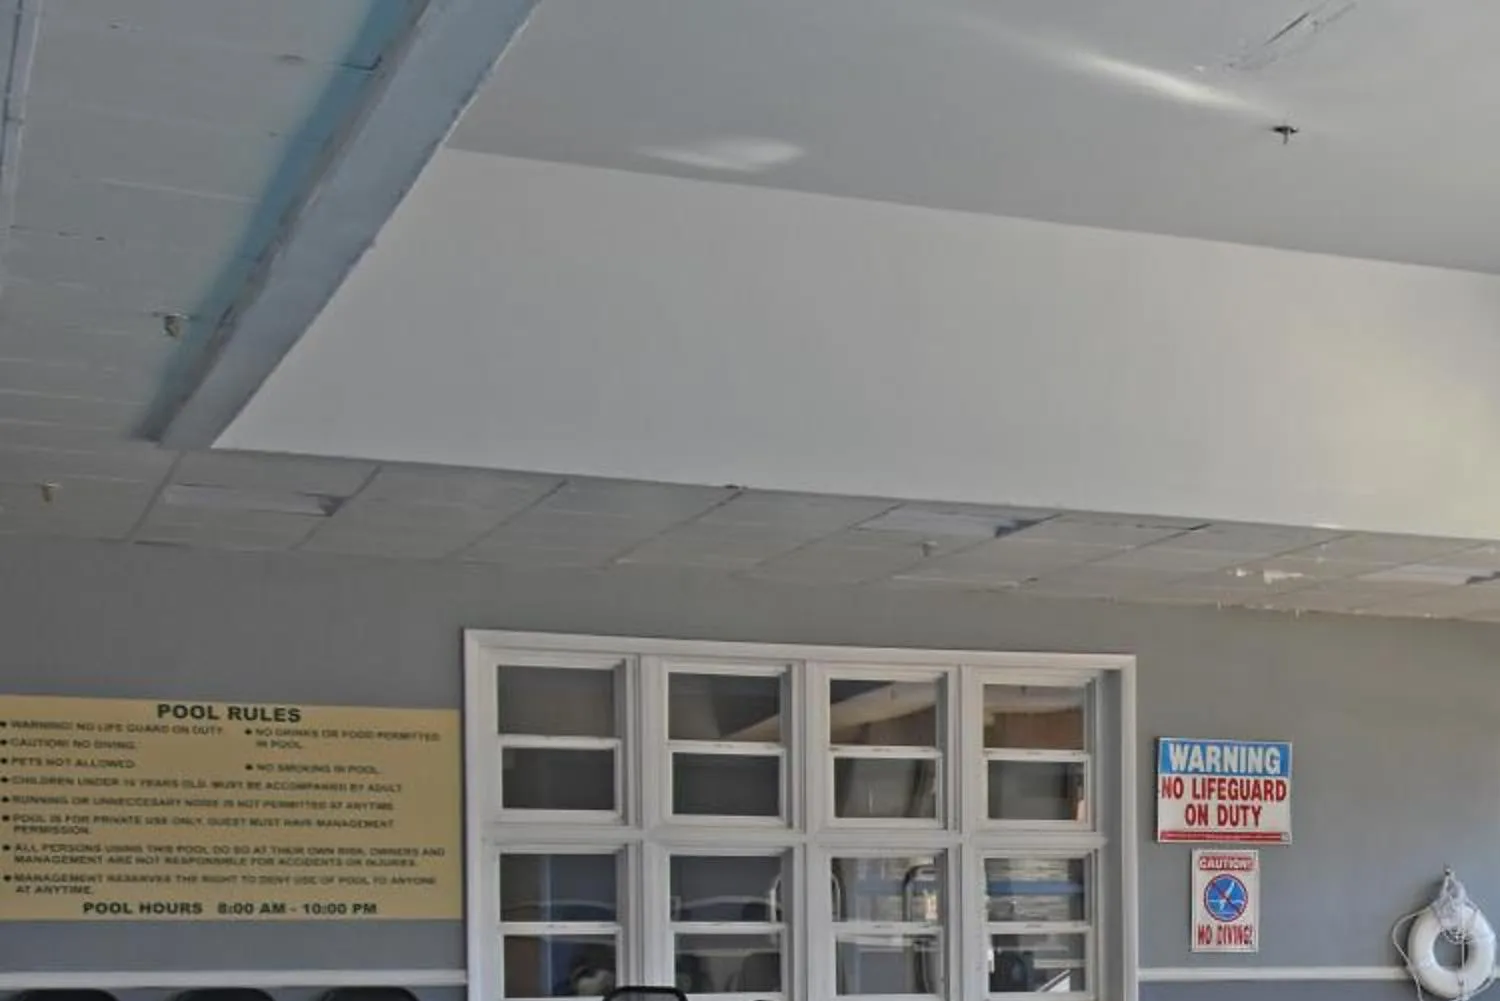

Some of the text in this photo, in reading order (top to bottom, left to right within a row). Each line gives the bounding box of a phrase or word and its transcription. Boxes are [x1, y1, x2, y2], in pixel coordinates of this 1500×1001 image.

[157, 703, 302, 723] POOL RULES
[76, 722, 95, 731] NO
[98, 723, 123, 733] LIFE
[127, 724, 170, 733] GUARD
[171, 725, 189, 734] ON
[255, 729, 273, 737] NO
[321, 730, 339, 739] OR
[341, 730, 373, 739] FOOD
[73, 740, 91, 749] NO
[11, 757, 42, 767] PETS
[46, 758, 71, 768] NOT
[1168, 743, 1281, 774] WARNING
[256, 764, 274, 773] NO
[277, 765, 331, 774] SMOKING
[11, 776, 74, 785] CHILDREN
[77, 777, 119, 786] UNDER
[140, 779, 178, 788] YEARS
[211, 781, 243, 790] MUST
[247, 782, 261, 790] BE
[350, 783, 364, 792] BY
[1161, 776, 1287, 802] NO LIFEGUARD
[11, 795, 68, 804] RUNNING
[71, 797, 89, 805] OR
[184, 799, 218, 808] NOISE
[237, 800, 259, 808] NOT
[262, 800, 327, 810] PERMITTED
[330, 801, 342, 810] AT
[12, 814, 46, 823] POOL
[50, 815, 62, 823] IS
[65, 815, 89, 824] FOR
[93, 816, 140, 825] PRIVATE
[145, 816, 167, 825] USE
[207, 818, 246, 826] GUEST
[250, 818, 280, 827] MUST
[283, 819, 312, 827] HAVE
[316, 819, 394, 829] MANAGEMENT
[1184, 803, 1263, 827] ON DUTY
[15, 844, 38, 853] ALL
[42, 844, 101, 853] PERSONS
[105, 845, 143, 853] USING
[147, 845, 173, 854] THIS
[176, 845, 209, 855] POOL
[212, 845, 230, 854] DO
[253, 845, 267, 855] AT
[270, 846, 304, 855] THEIR
[307, 847, 335, 856] OWN
[369, 848, 418, 857] OWNERS
[422, 848, 446, 857] AND
[14, 855, 102, 865] MANAGEMENT
[107, 856, 132, 865] ARE
[135, 857, 160, 865] NOT
[164, 857, 247, 866] RESPONSIBLE
[250, 858, 274, 867] FOR
[278, 858, 342, 867] ACCIDENTS
[345, 859, 362, 867] OR
[14, 873, 103, 883] MANAGEMENT
[107, 874, 171, 883] RESERVES
[176, 875, 197, 884] THE
[201, 876, 237, 884] RIGHT
[241, 876, 257, 884] TO
[294, 876, 317, 886] USE
[319, 876, 335, 885] OF
[338, 877, 370, 886] POOL
[372, 877, 387, 885] TO
[391, 877, 437, 886] ANYONE
[15, 885, 30, 895] AT
[82, 901, 133, 915] POOL
[138, 901, 203, 915] HOURS
[217, 902, 254, 915] 8:00
[259, 902, 287, 915] AM
[303, 902, 348, 915] 10:00
[352, 902, 378, 915] PM
[1197, 923, 1213, 945] NO
